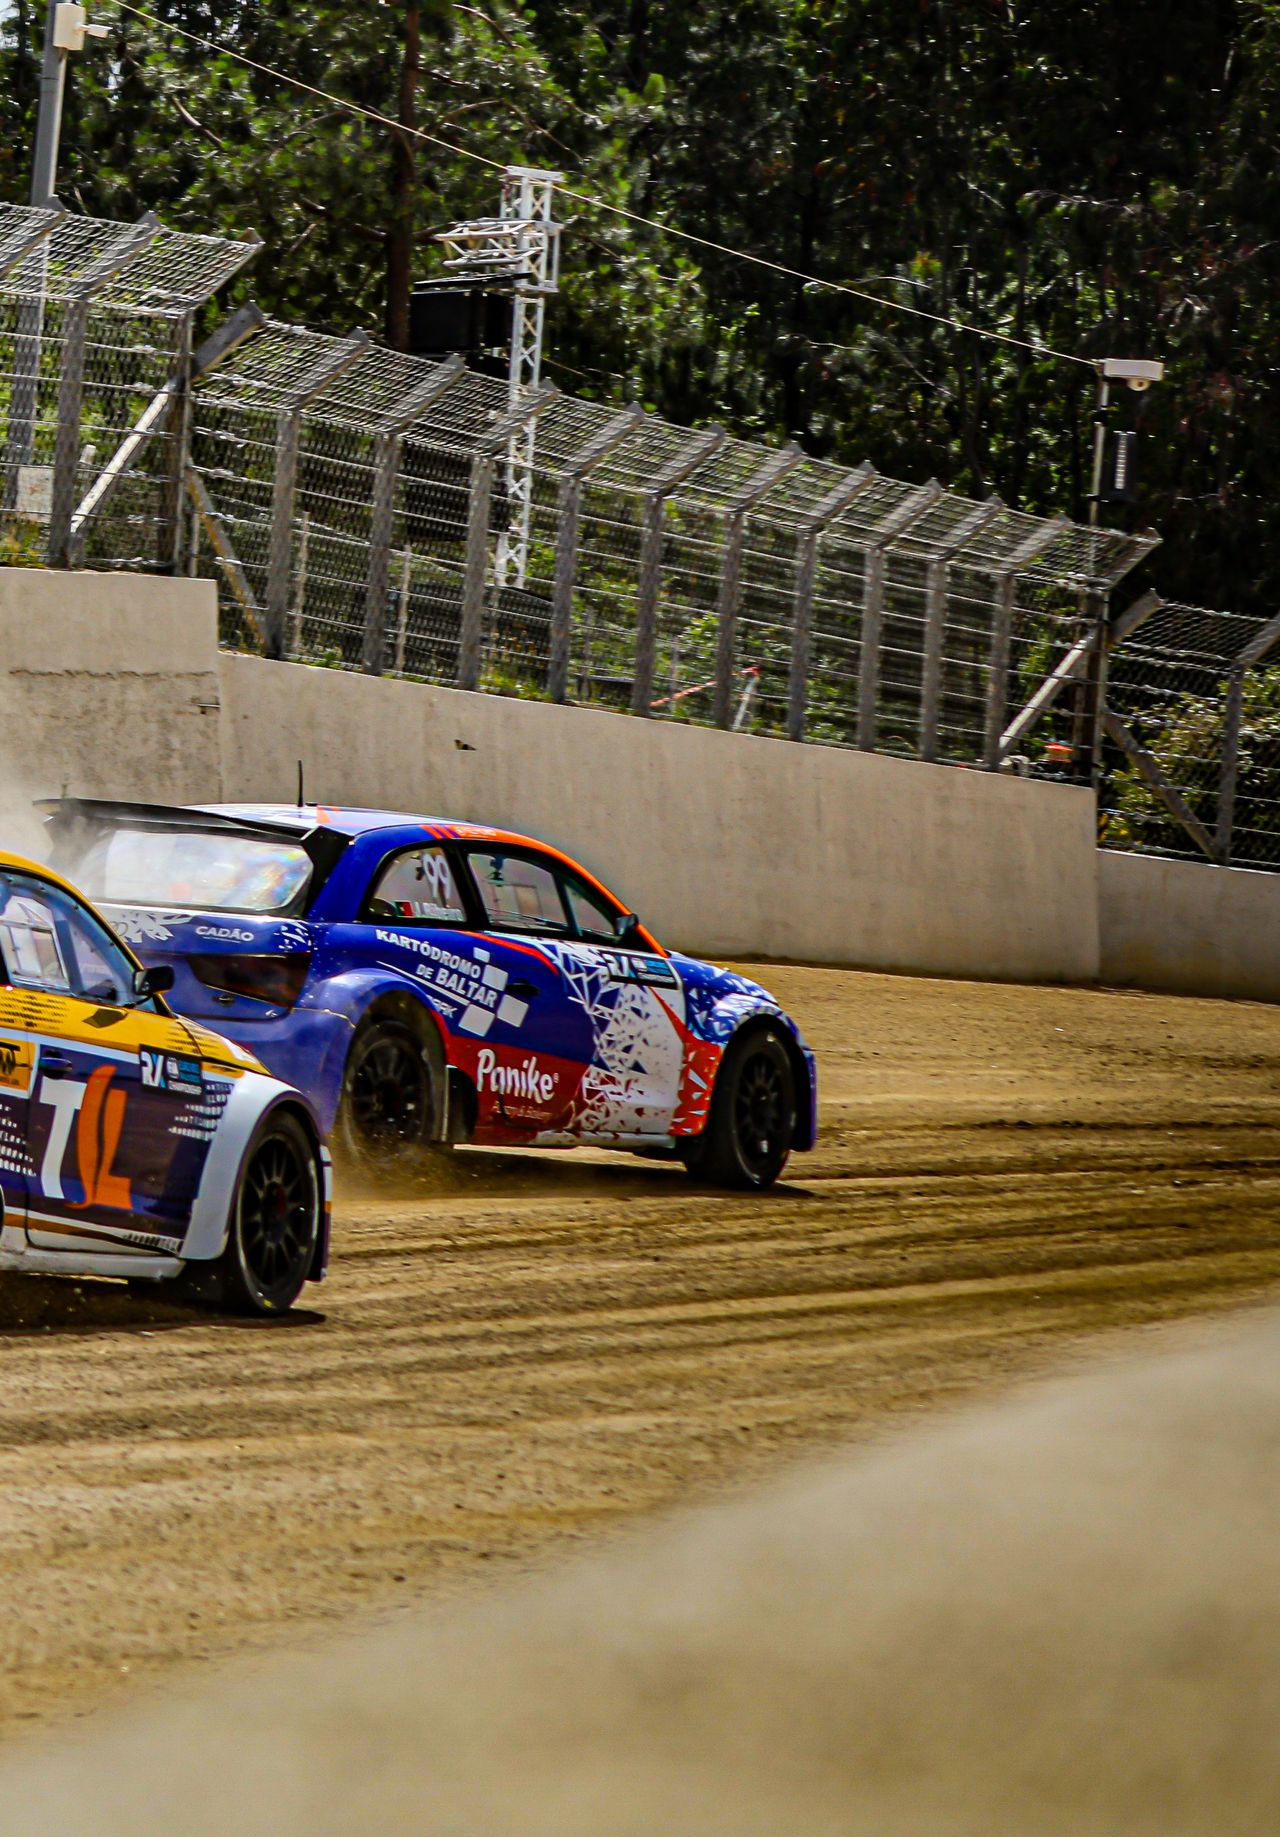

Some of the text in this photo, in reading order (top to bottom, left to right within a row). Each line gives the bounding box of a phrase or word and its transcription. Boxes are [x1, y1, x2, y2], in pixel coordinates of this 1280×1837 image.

[422, 853, 451, 898] 99
[196, 926, 254, 941] CADÃO
[376, 929, 480, 979] KARTÓDROMO
[416, 964, 433, 978] DE
[435, 968, 498, 1007] BALTAR
[476, 1048, 555, 1103] Panike
